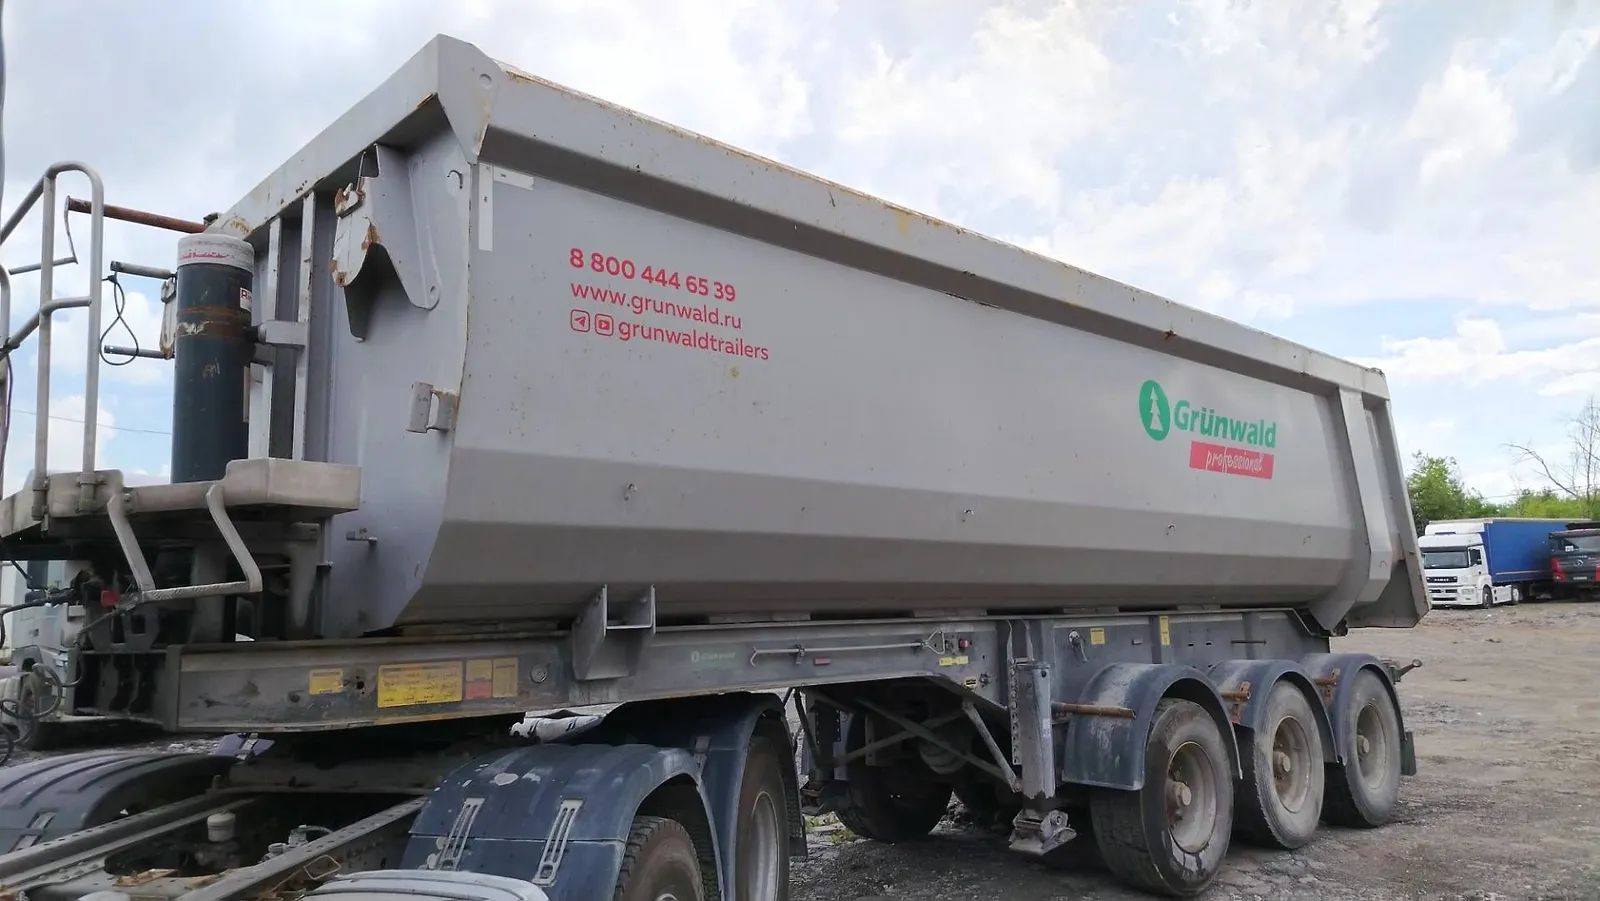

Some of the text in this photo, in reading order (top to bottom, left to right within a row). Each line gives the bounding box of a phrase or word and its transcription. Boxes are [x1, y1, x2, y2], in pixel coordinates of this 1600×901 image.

[569, 248, 736, 302] 8 800 444 65 39
[570, 283, 742, 329] www.grunwald.ru
[618, 321, 769, 360] grunwaldtrailers
[1174, 400, 1277, 448] Grünwald
[1205, 446, 1264, 475] professional
